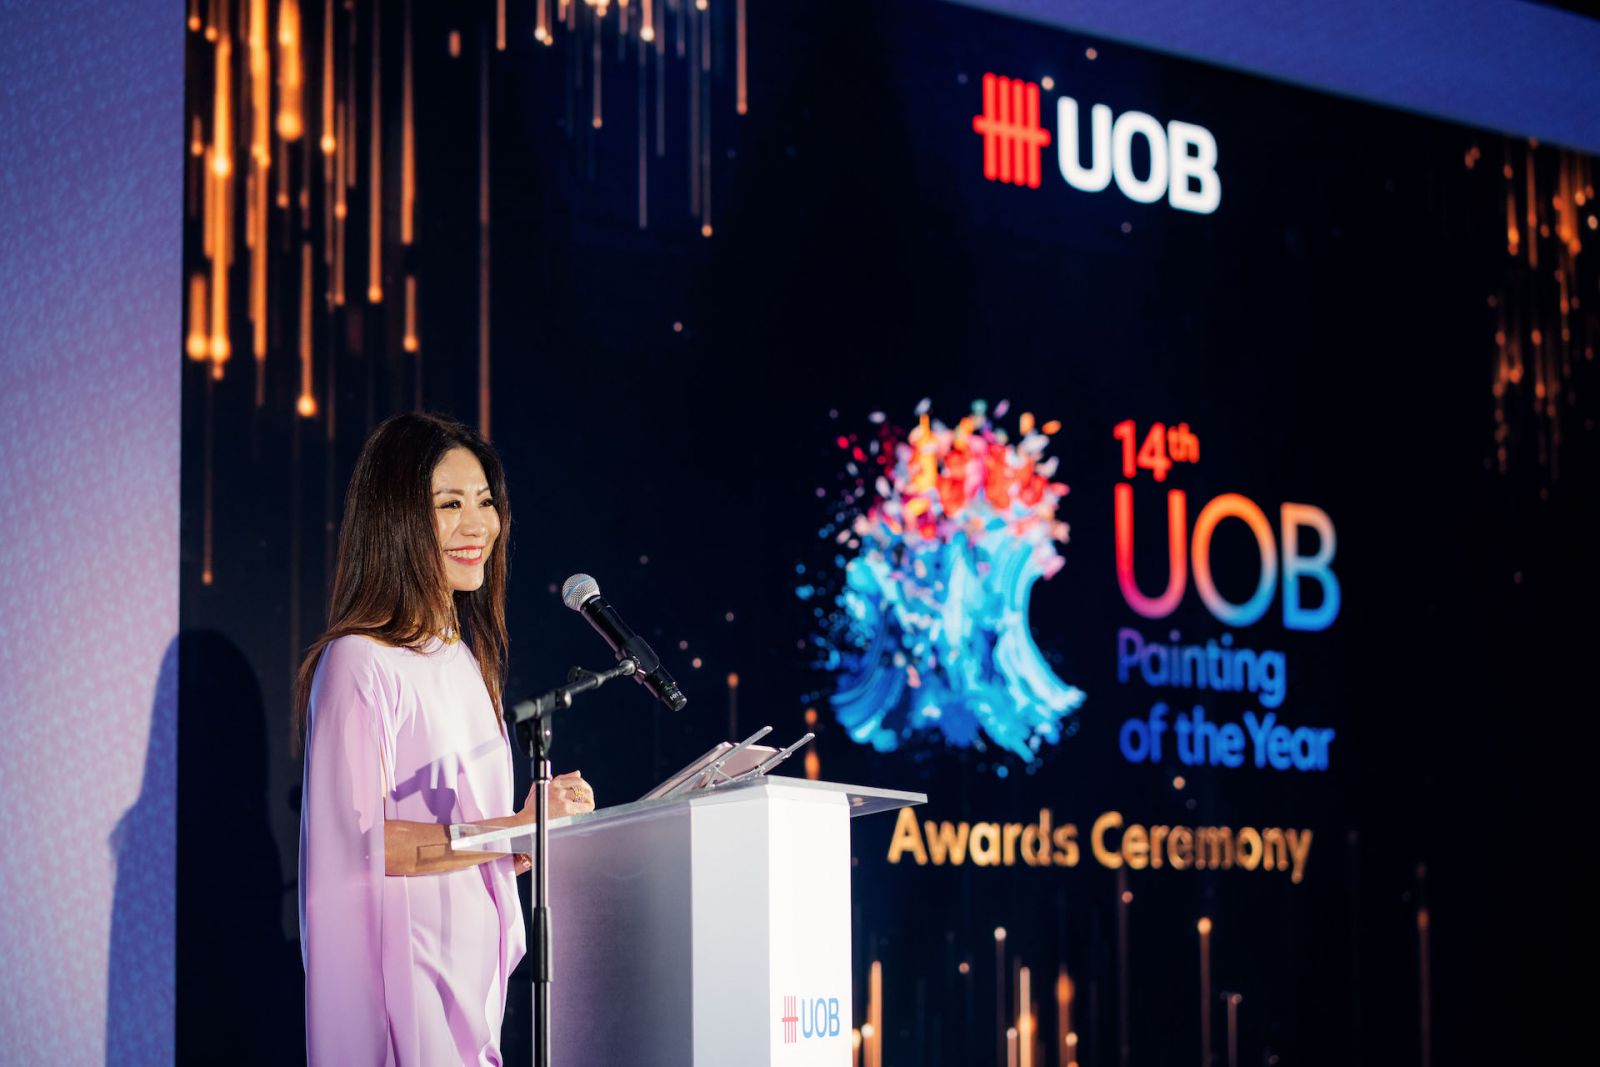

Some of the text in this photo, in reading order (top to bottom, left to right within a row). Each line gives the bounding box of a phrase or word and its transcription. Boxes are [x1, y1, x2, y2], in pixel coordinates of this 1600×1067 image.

[1057, 96, 1221, 215] UOB
[1113, 419, 1200, 482] 14th
[1114, 482, 1341, 631] UOB
[1117, 627, 1287, 708] Painting
[1119, 702, 1336, 771] of the Year
[887, 805, 1314, 885] Awards Ceremony
[802, 997, 840, 1039] UOB
